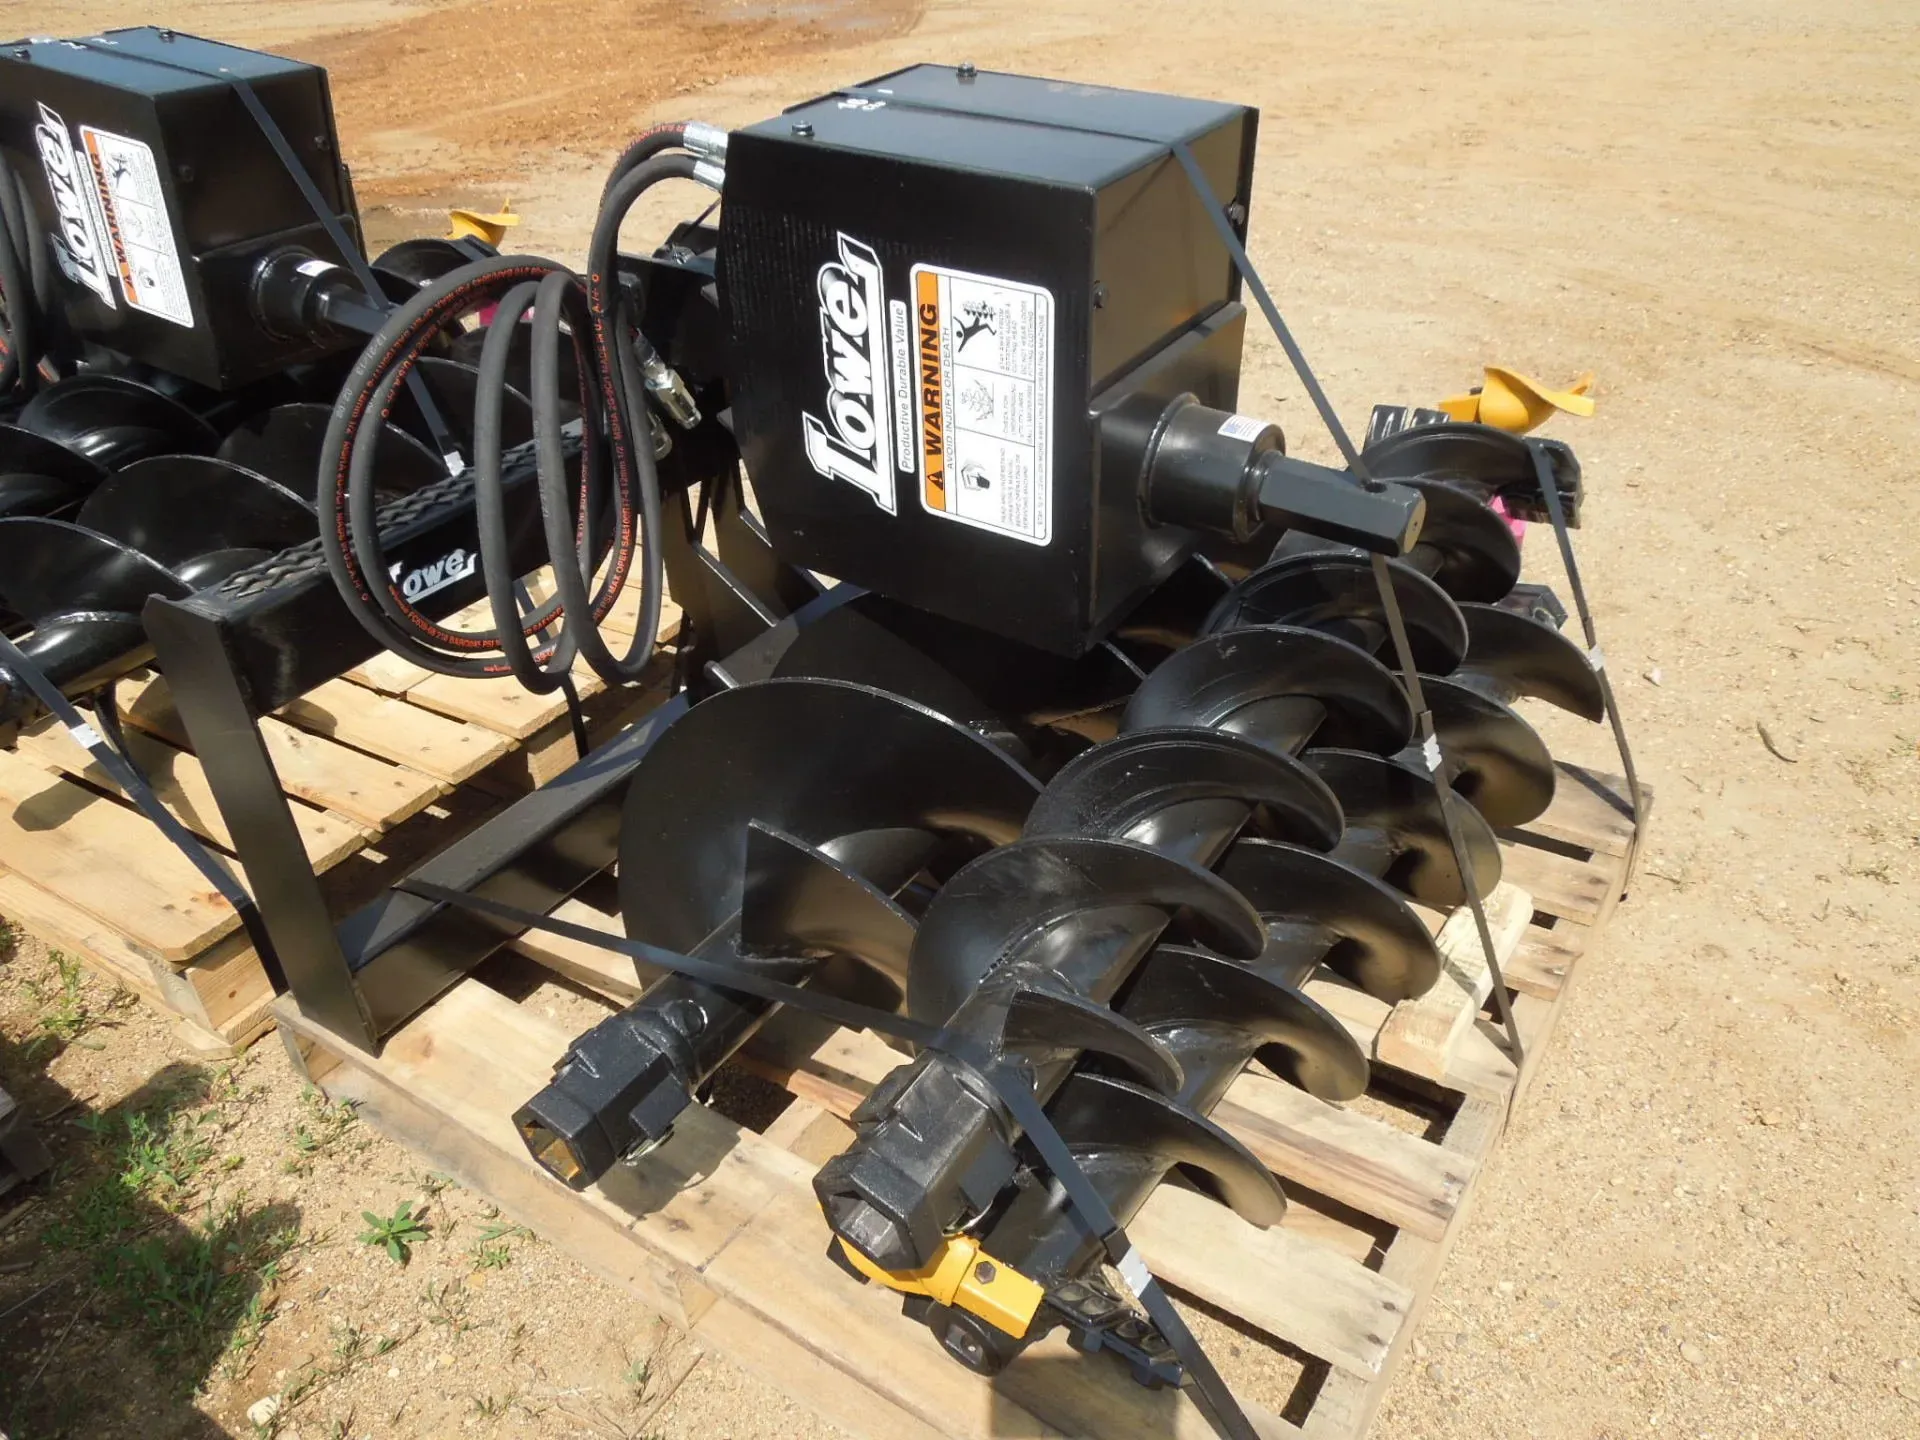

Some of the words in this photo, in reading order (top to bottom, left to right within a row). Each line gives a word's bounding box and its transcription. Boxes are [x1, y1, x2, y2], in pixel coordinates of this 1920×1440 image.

[88, 151, 127, 265] WARNING
[893, 306, 905, 344] Value
[597, 345, 609, 373] MADE
[942, 326, 951, 367] DEATH
[895, 347, 908, 399] Durable
[918, 301, 942, 458] WARNING
[943, 369, 951, 387] OR
[944, 390, 953, 433] INJURY
[897, 401, 912, 469] Productive
[946, 434, 954, 470] AVOID
[619, 460, 628, 487] 12mm
[616, 548, 628, 574] OPER
[609, 574, 621, 594] MAX
